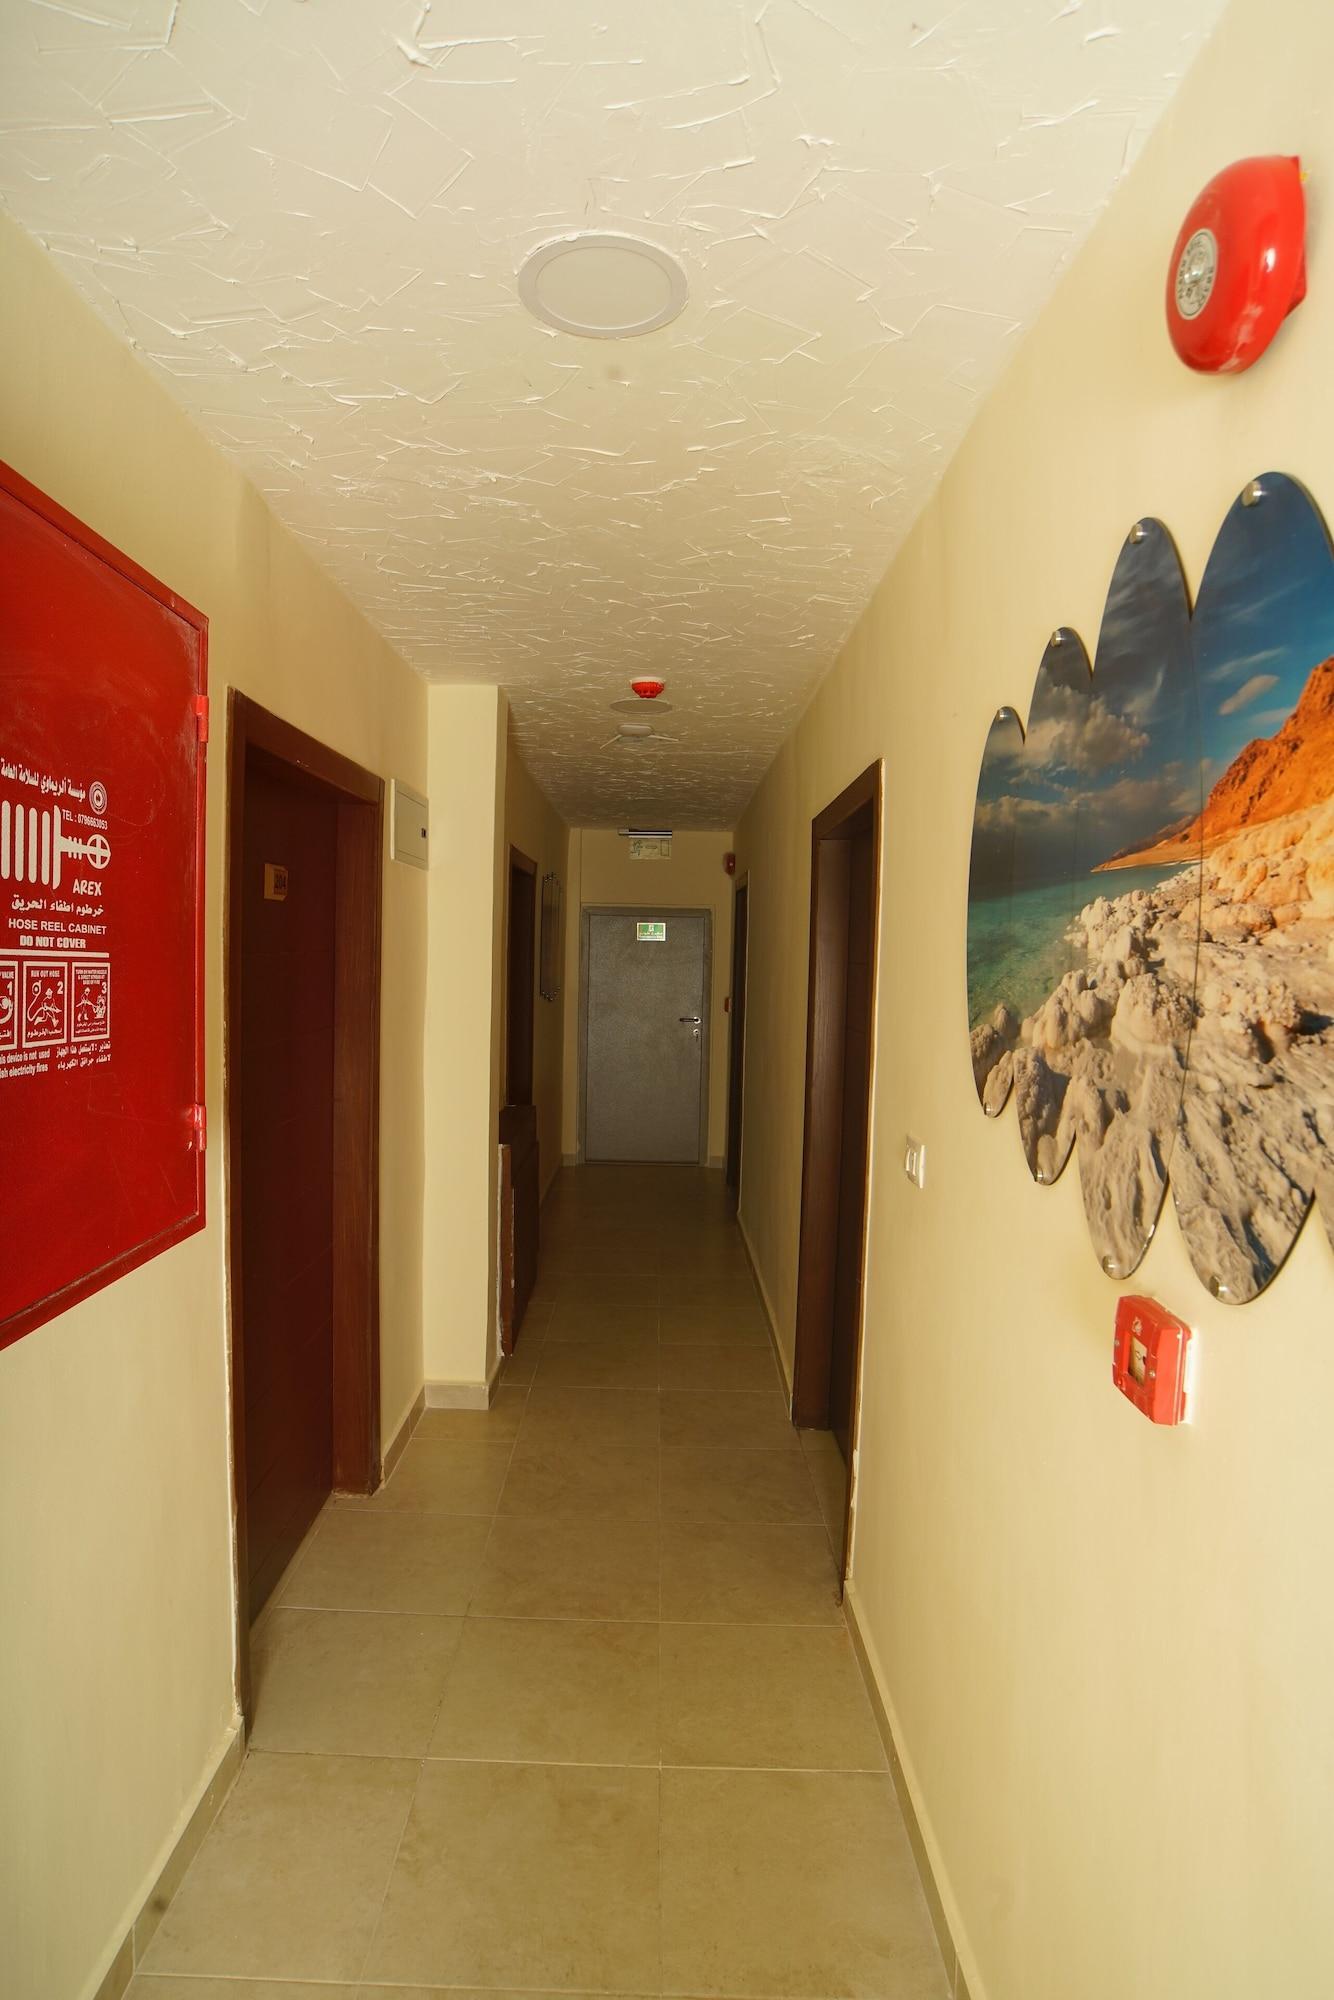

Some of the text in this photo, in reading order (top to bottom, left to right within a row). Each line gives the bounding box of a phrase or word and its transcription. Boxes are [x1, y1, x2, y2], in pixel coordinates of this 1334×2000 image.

[62, 808, 73, 822] TEL
[72, 878, 102, 896] AREX
[11, 894, 47, 913] الحريق
[76, 904, 104, 917] خرطوم
[8, 918, 107, 935] HOSE REEL CABINET
[20, 935, 86, 949] DO NOT COVER
[6, 981, 13, 996] 1
[57, 981, 63, 995] 2
[101, 981, 107, 994] 3
